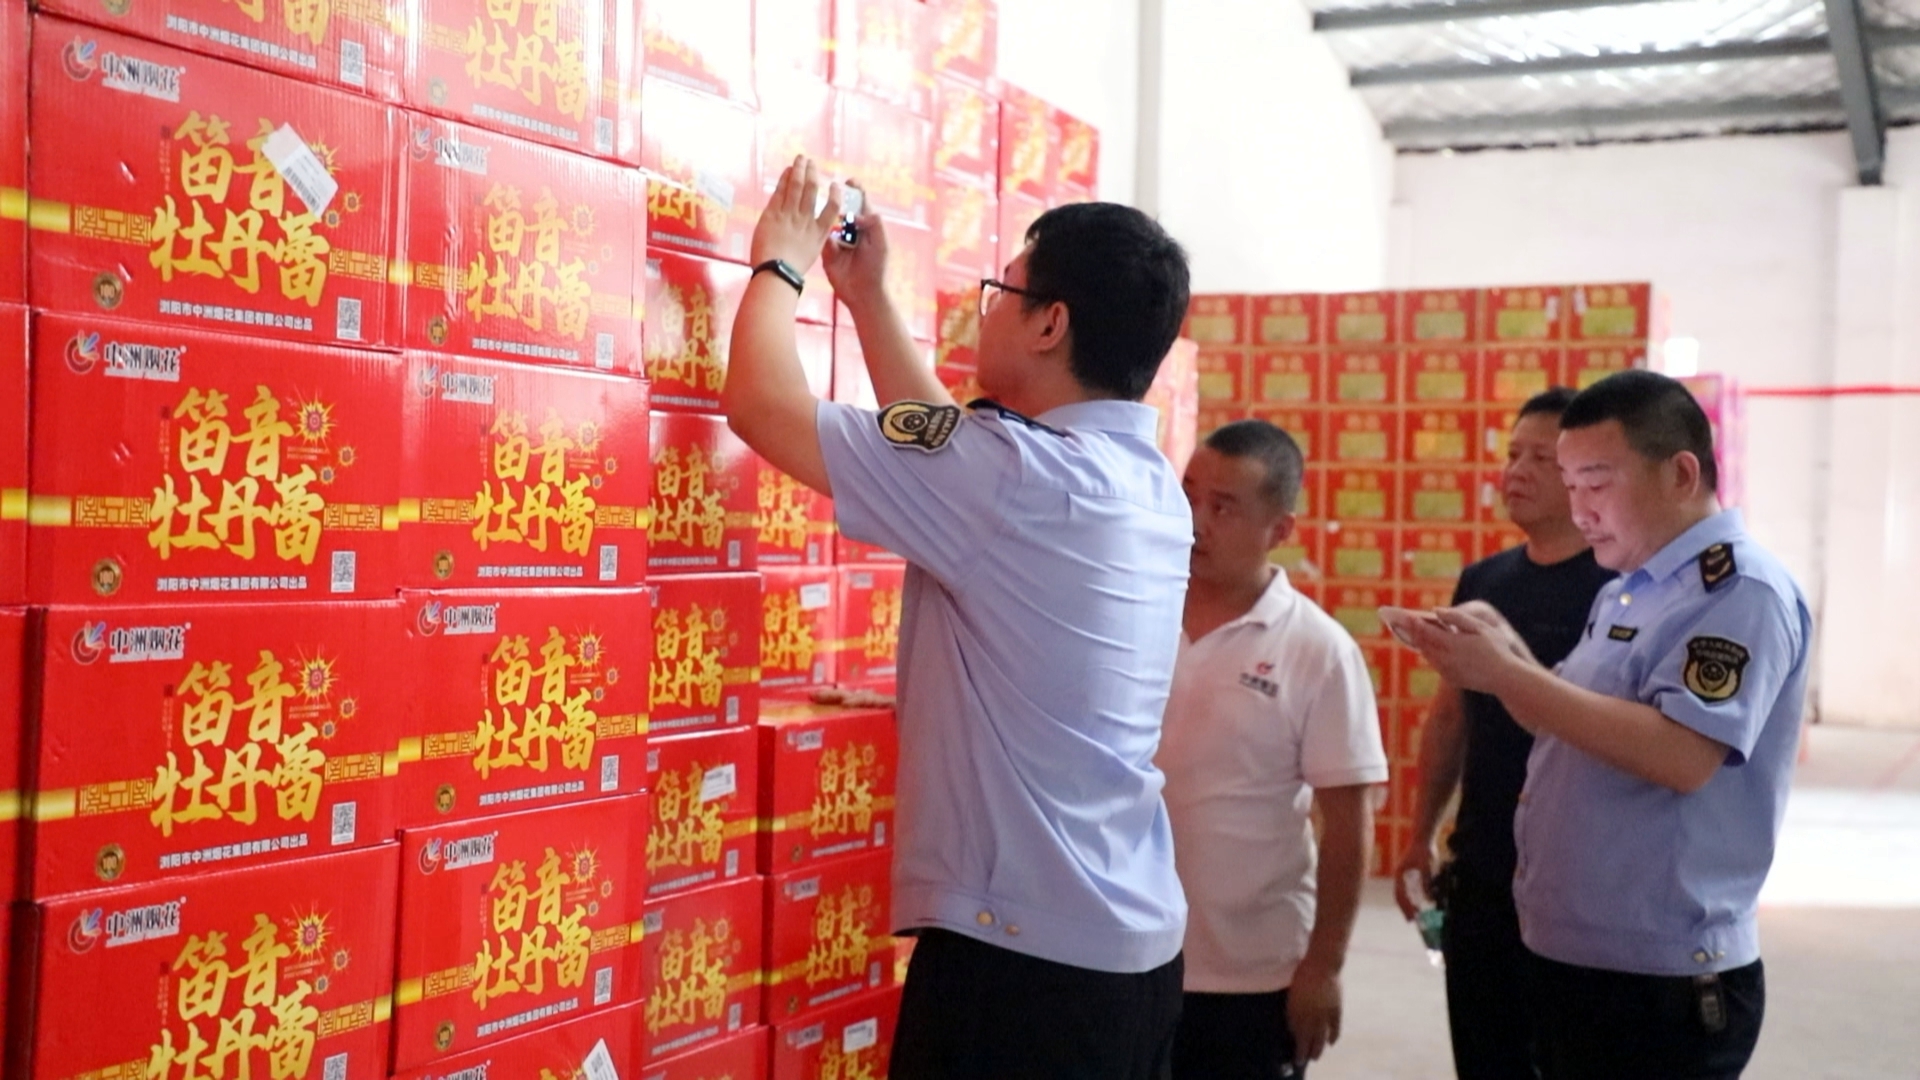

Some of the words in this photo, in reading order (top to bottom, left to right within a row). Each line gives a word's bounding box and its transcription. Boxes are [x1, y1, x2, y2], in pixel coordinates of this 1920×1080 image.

[149, 194, 330, 307] 牡丹蕾
[484, 181, 569, 267] 笛音
[466, 251, 591, 342] 牡丹蕾
[173, 385, 294, 481] 笛音
[489, 405, 575, 487] 笛音
[654, 443, 709, 499] 笛音
[148, 463, 325, 565] 牡丹蕾
[471, 471, 596, 558] 牡丹蕾
[646, 487, 726, 550] 牡丹蕾
[490, 625, 576, 706] 笛音
[654, 602, 709, 660] 笛音
[177, 649, 297, 747] 笛音
[648, 646, 725, 712] 牡丹蕾
[472, 686, 598, 781] 牡丹蕾
[150, 721, 326, 838] 牡丹蕾
[645, 802, 725, 876] 牡丹蕾
[489, 846, 571, 934] 笛音
[173, 913, 292, 1021] 笛音
[471, 902, 592, 1012] 牡丹蕾
[646, 957, 728, 1037] 牡丹蕾
